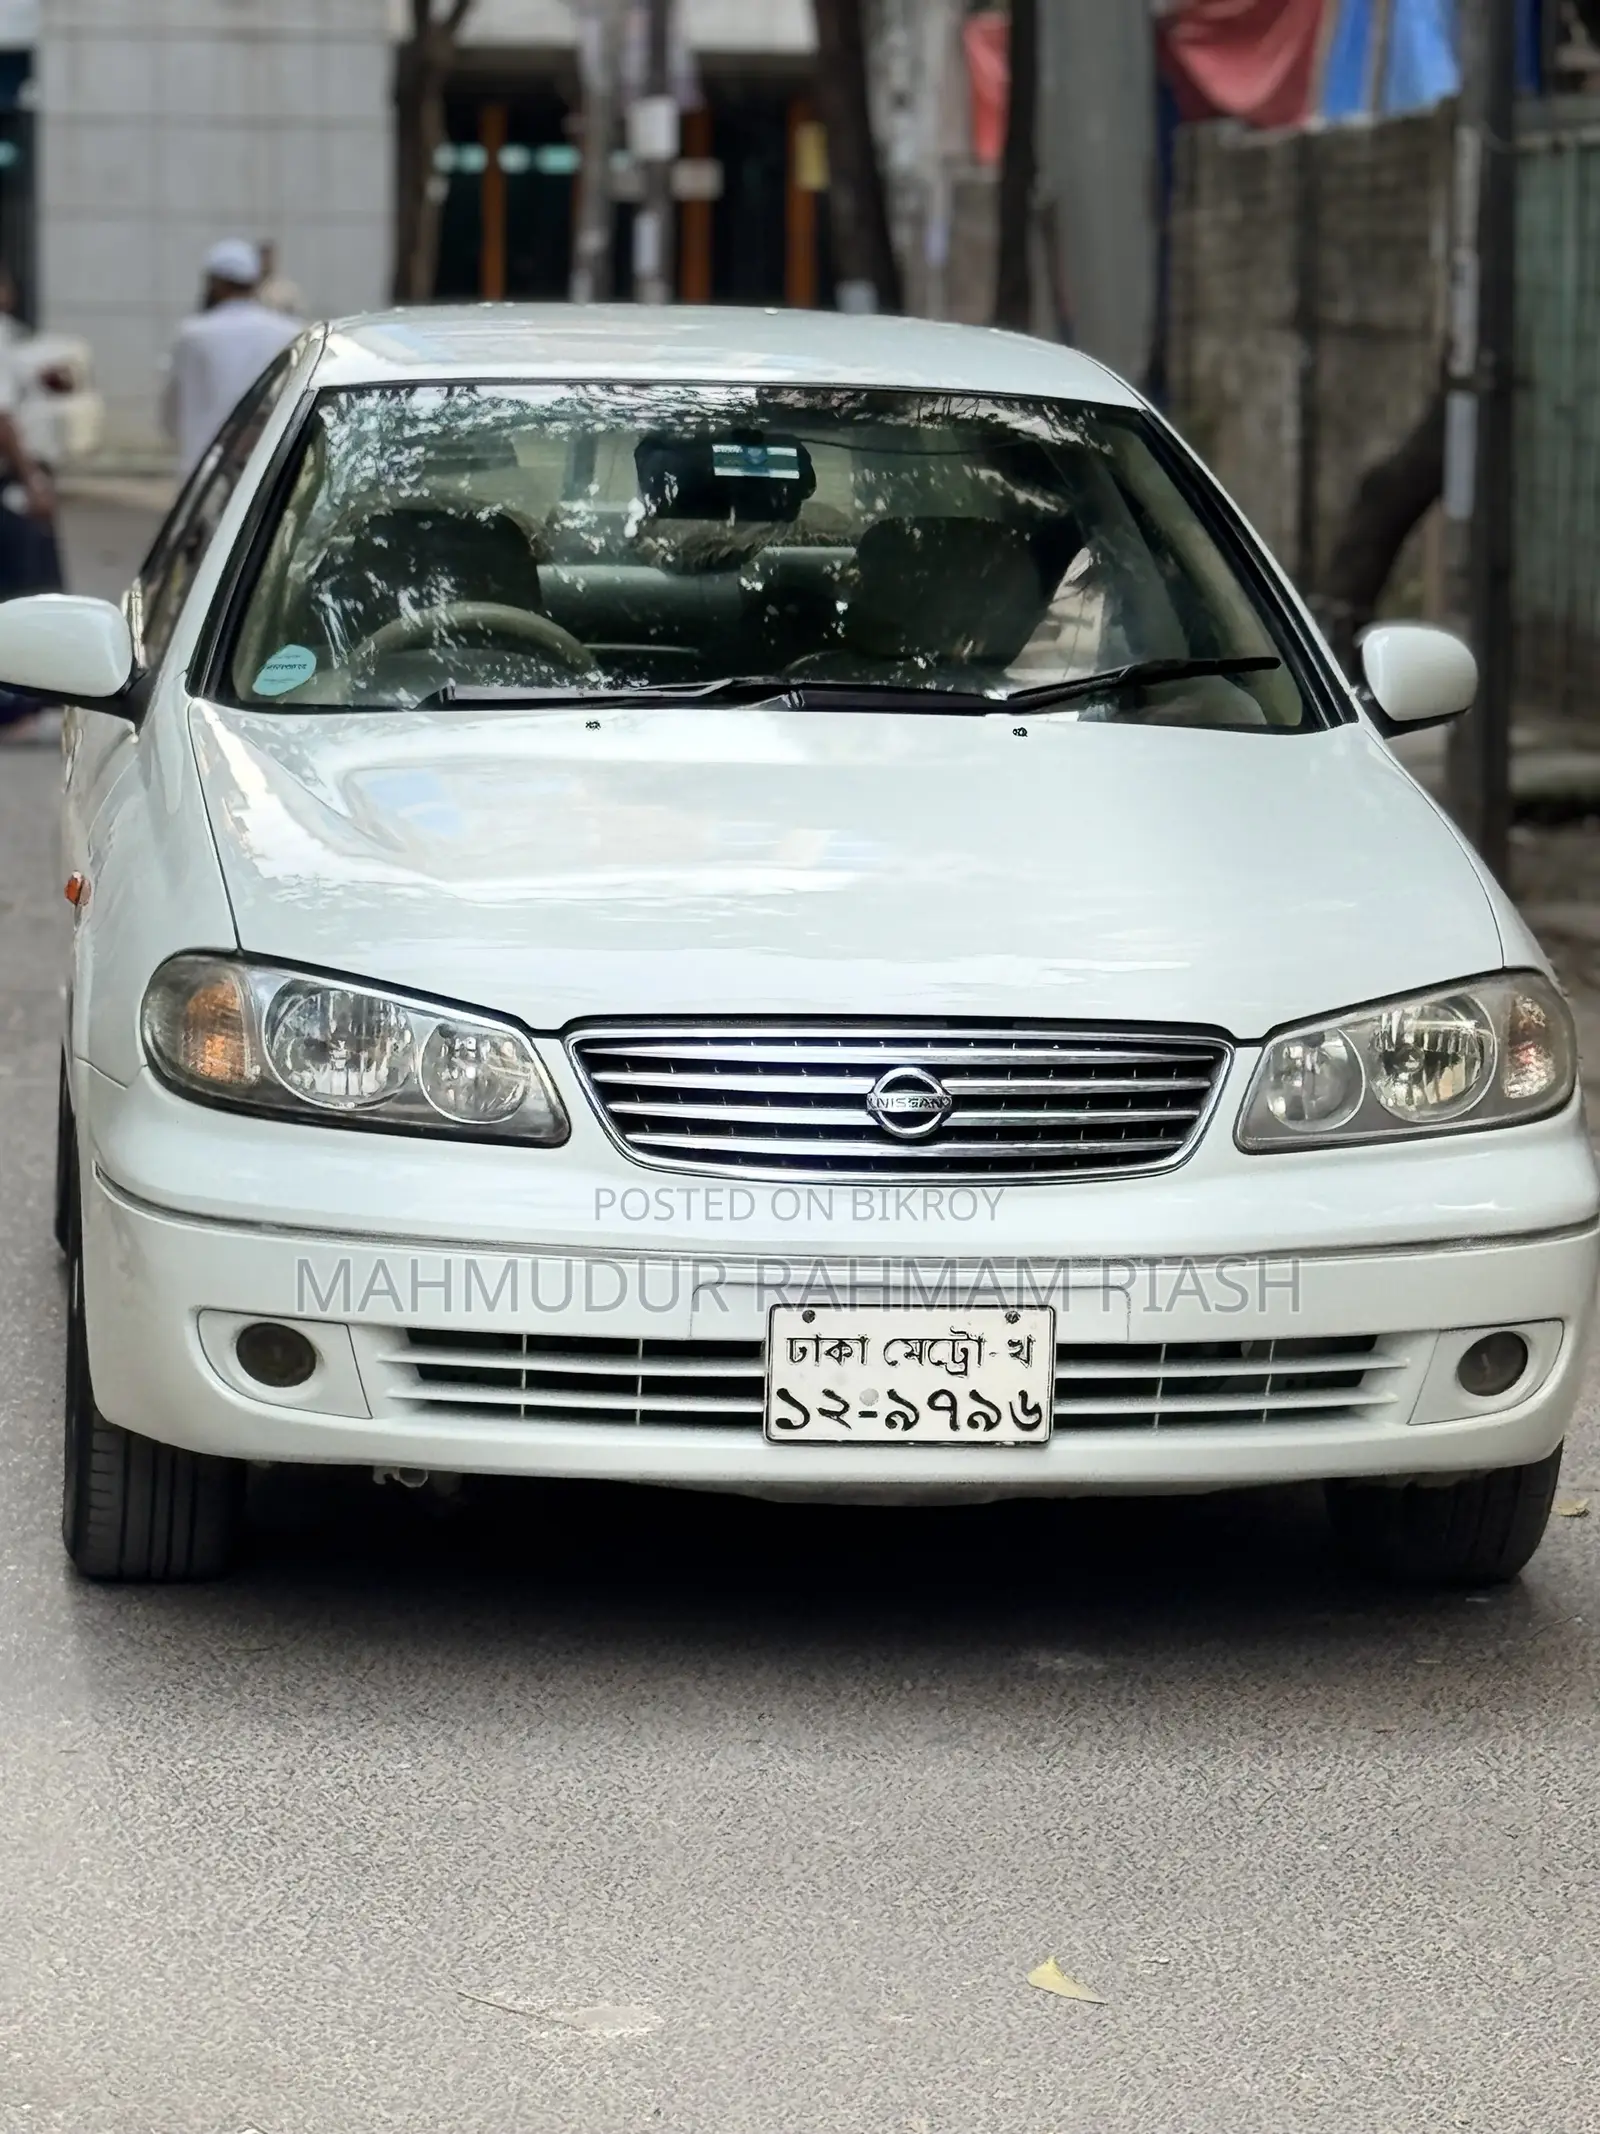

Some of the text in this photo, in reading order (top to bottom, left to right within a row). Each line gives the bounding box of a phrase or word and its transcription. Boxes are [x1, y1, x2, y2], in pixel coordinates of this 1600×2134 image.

[876, 1096, 942, 1109] NISSAN
[785, 1333, 870, 1366] ঢাকা
[775, 1387, 1043, 1431] ১২-৯৭৯৬
